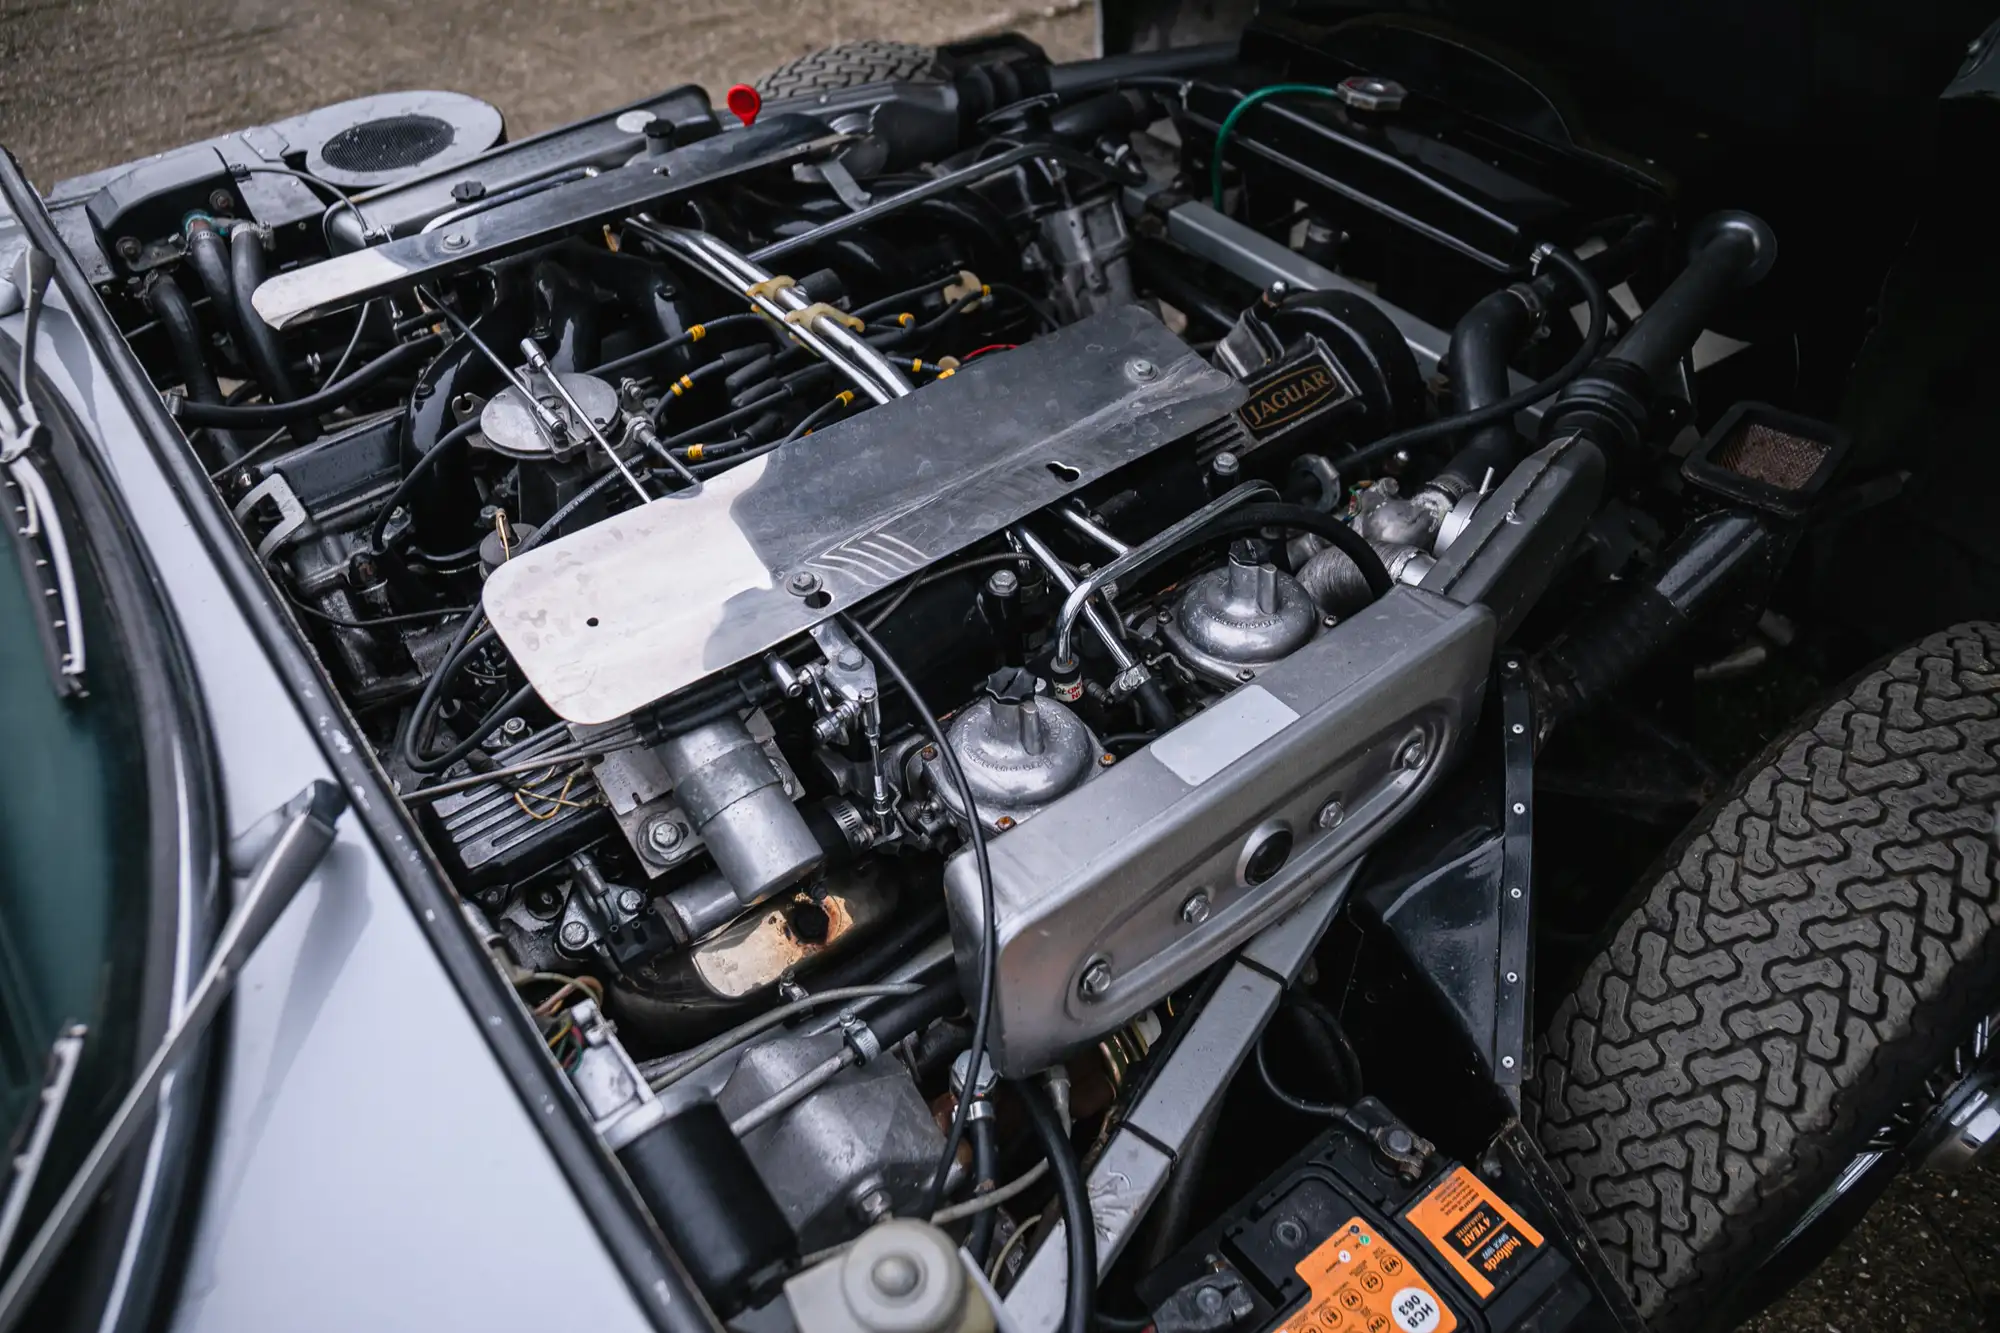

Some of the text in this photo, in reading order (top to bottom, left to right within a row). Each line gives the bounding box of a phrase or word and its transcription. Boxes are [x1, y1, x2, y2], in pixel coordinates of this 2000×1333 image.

[1249, 371, 1330, 425] JAGUAR
[1456, 1211, 1485, 1239] GUARANTEE
[1461, 1217, 1491, 1248] 4 YEAR
[1483, 1235, 1522, 1272] halfords
[1386, 1258, 1400, 1273] W3
[1366, 1275, 1378, 1289] C2
[1346, 1295, 1359, 1307] V2
[1399, 1294, 1421, 1316] 063
[1370, 1317, 1386, 1333] 12V
[1407, 1303, 1434, 1328] HCB
